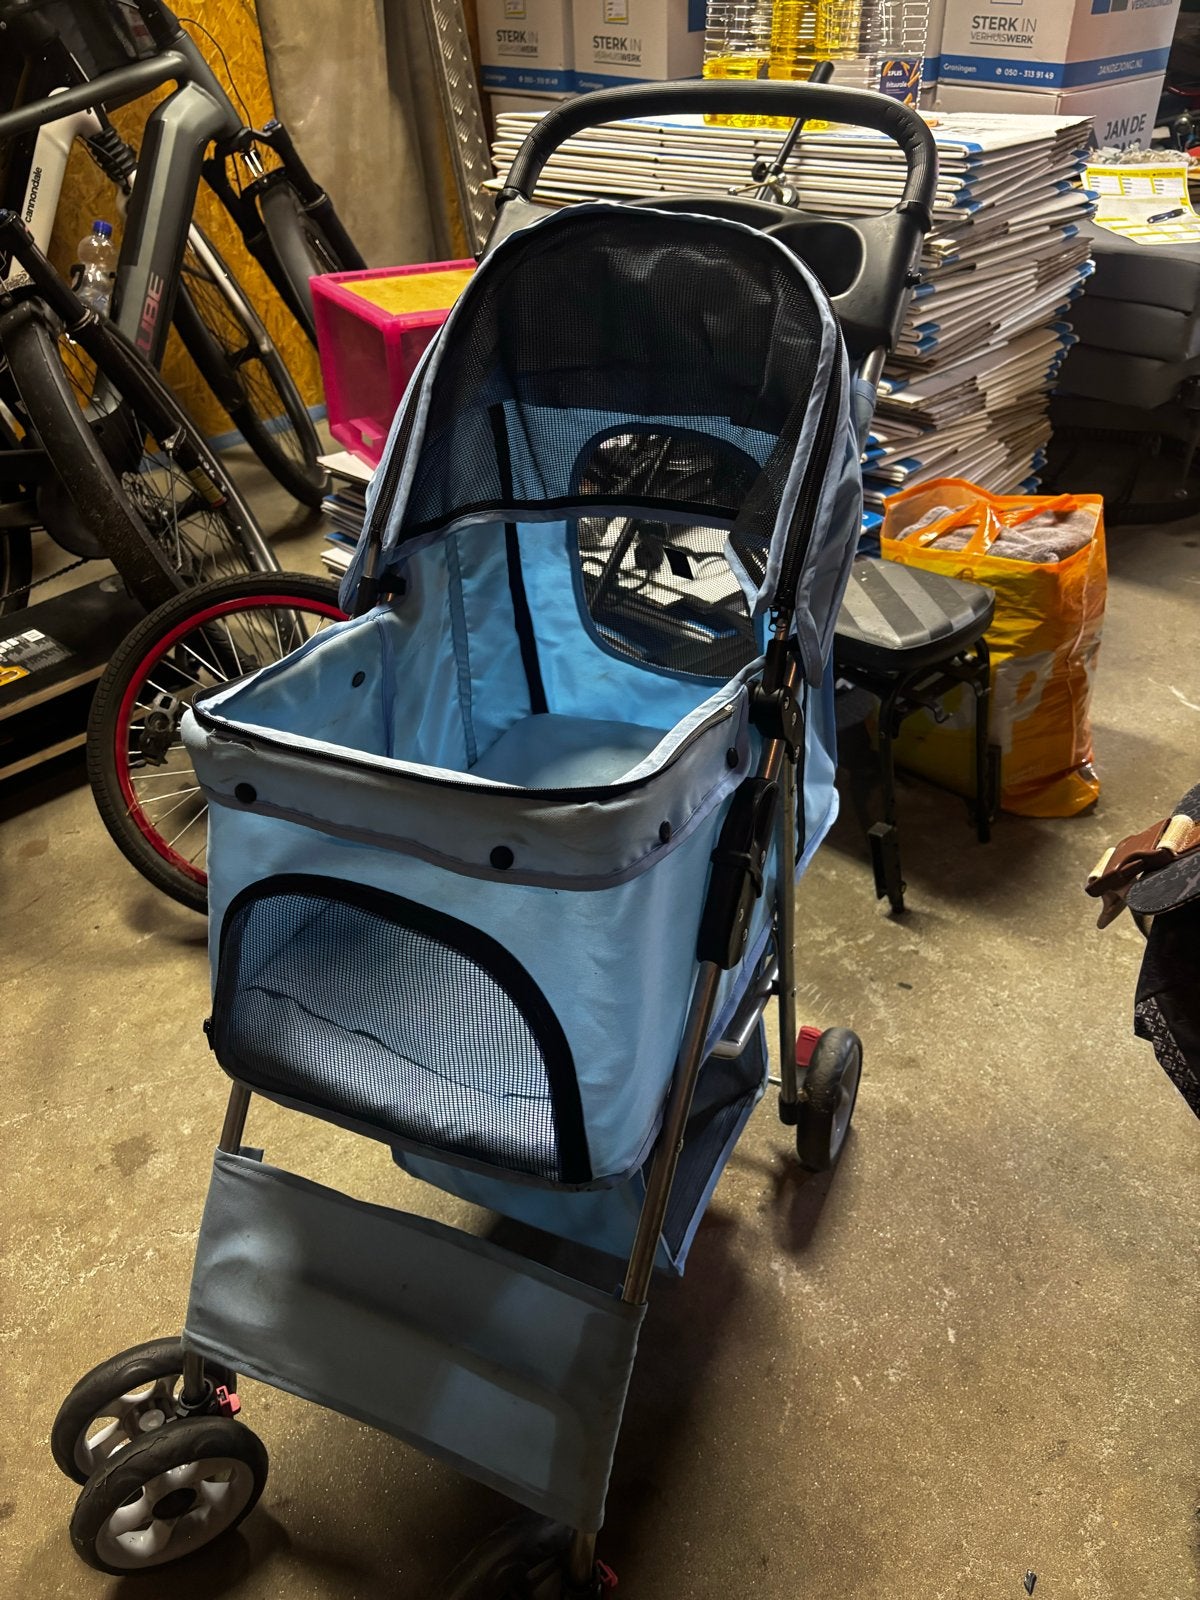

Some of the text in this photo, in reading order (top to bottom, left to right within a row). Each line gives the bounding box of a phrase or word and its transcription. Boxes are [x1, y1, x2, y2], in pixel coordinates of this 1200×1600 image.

[971, 15, 1037, 33] STERK IN
[496, 29, 539, 44] STERK IN
[593, 35, 642, 52] STERK IN
[970, 31, 1034, 44] VERHUISWERK
[943, 63, 977, 74] Groningen
[1004, 68, 1018, 77] 050
[1023, 70, 1035, 78] 313
[1035, 71, 1044, 79] 91
[1045, 71, 1055, 80] 49
[1104, 113, 1147, 141] JAN DE
[25, 166, 43, 223] cannondale
[136, 272, 165, 360] UBE
